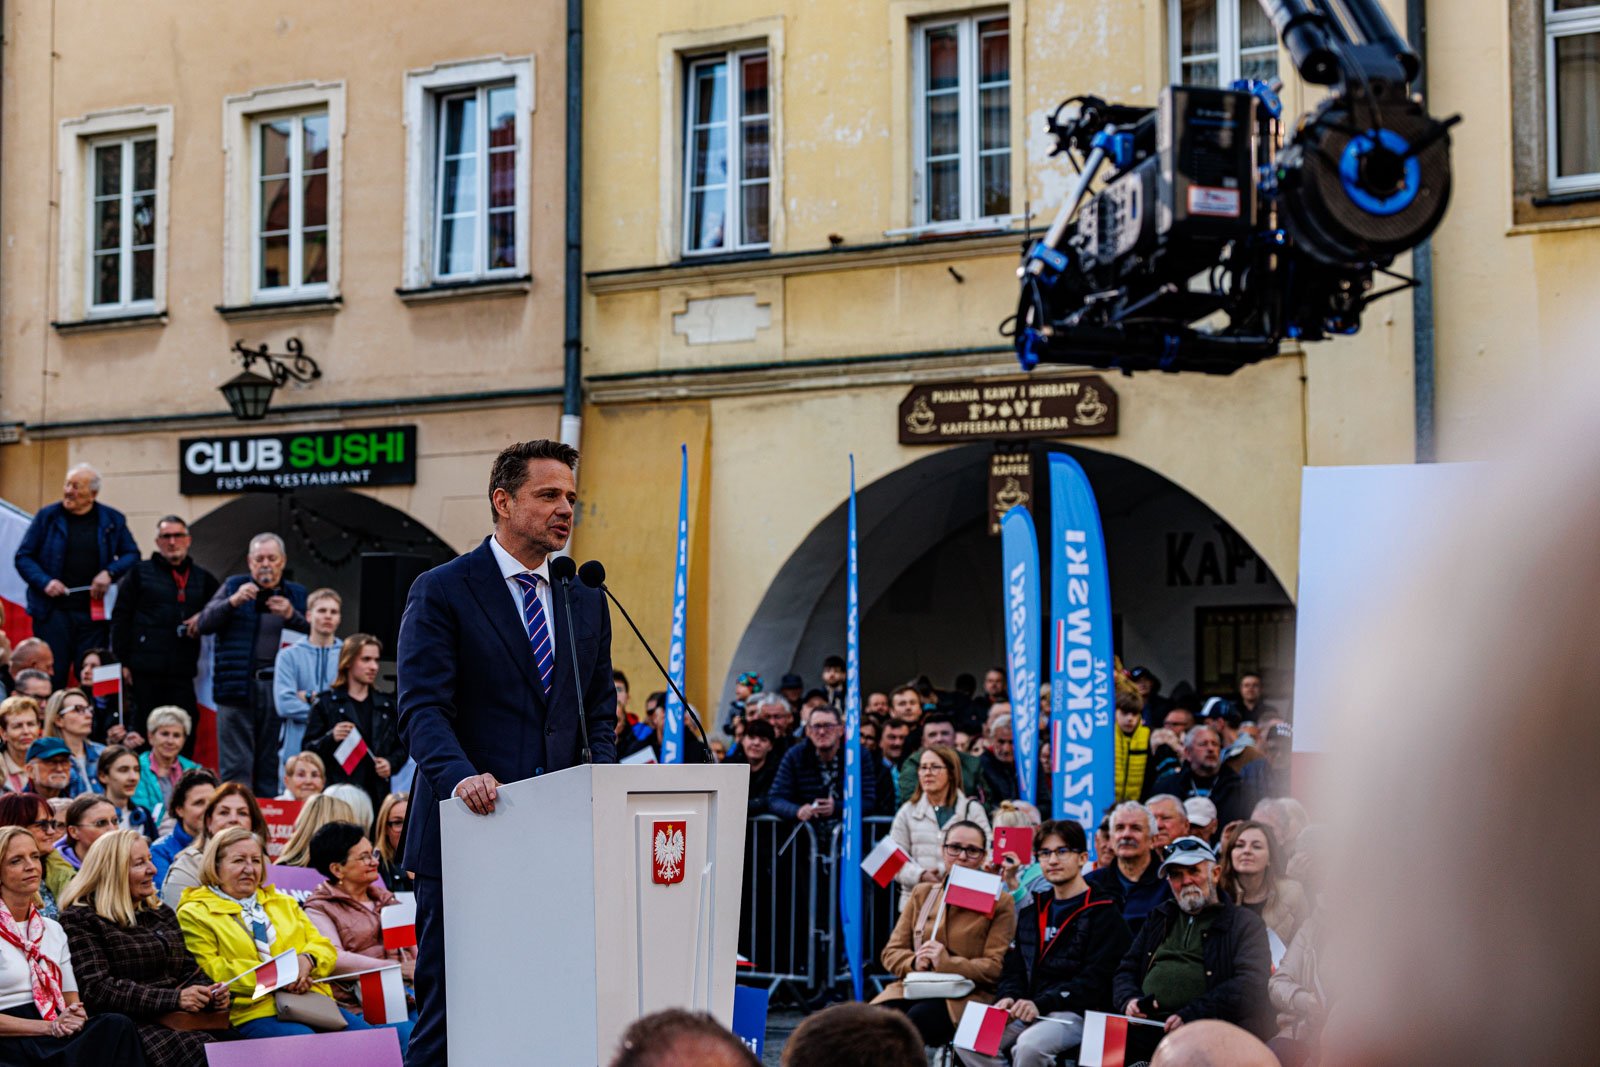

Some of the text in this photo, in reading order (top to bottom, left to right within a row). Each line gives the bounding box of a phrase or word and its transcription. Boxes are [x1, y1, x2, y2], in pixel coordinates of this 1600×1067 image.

[931, 383, 1080, 403] PIJALNIA KAWY I HERBATY
[940, 416, 1069, 435] KAFFEEBAR & TEEBAR
[185, 431, 404, 475] CLUB SUSHI
